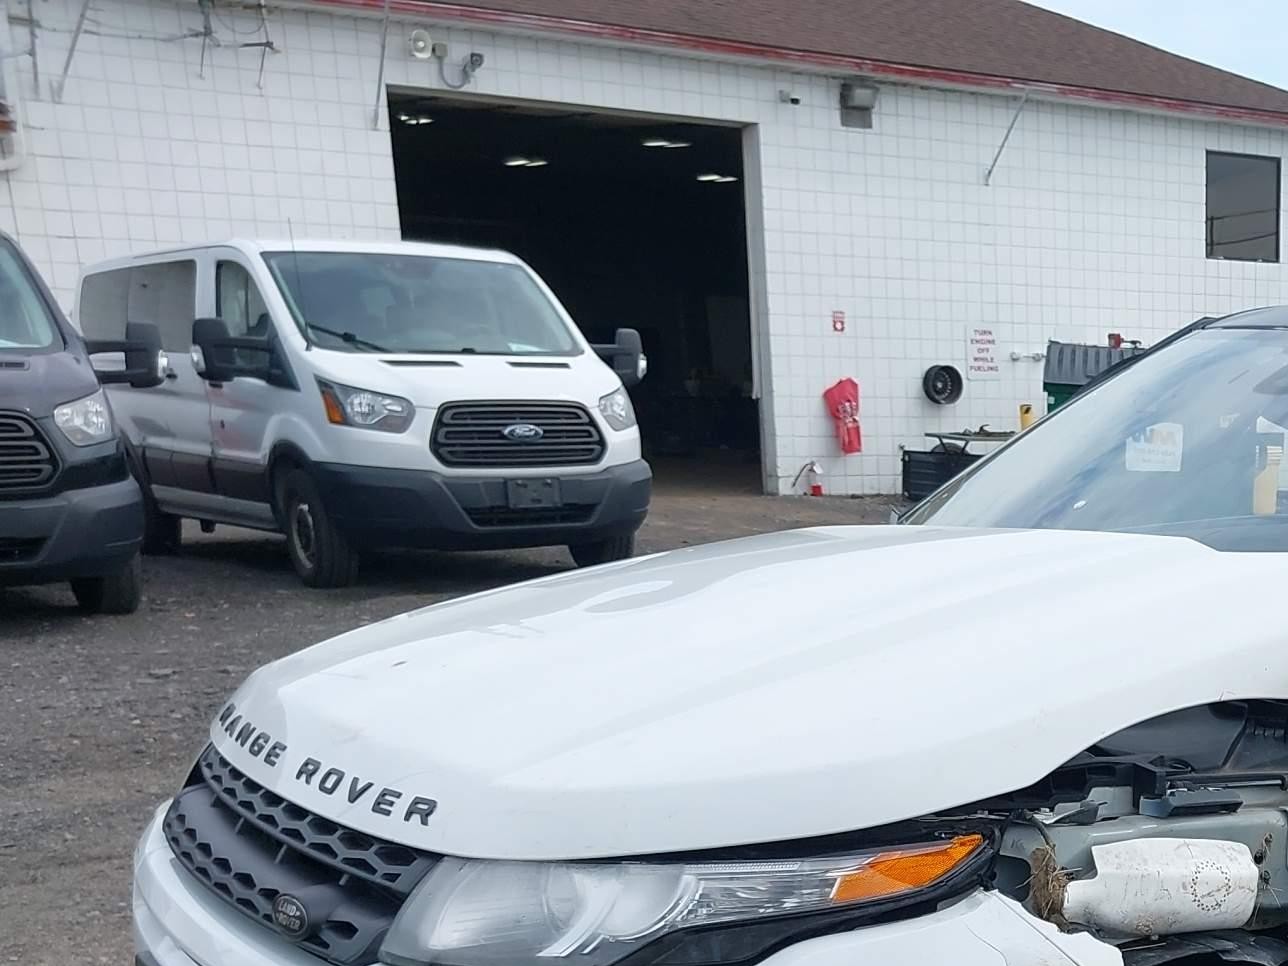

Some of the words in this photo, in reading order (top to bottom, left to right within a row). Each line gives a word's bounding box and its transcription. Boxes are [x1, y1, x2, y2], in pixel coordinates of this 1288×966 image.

[219, 703, 287, 767] RANGE
[295, 757, 438, 826] ROVER
[278, 900, 297, 916] LAND
[278, 911, 301, 930] ROVER
